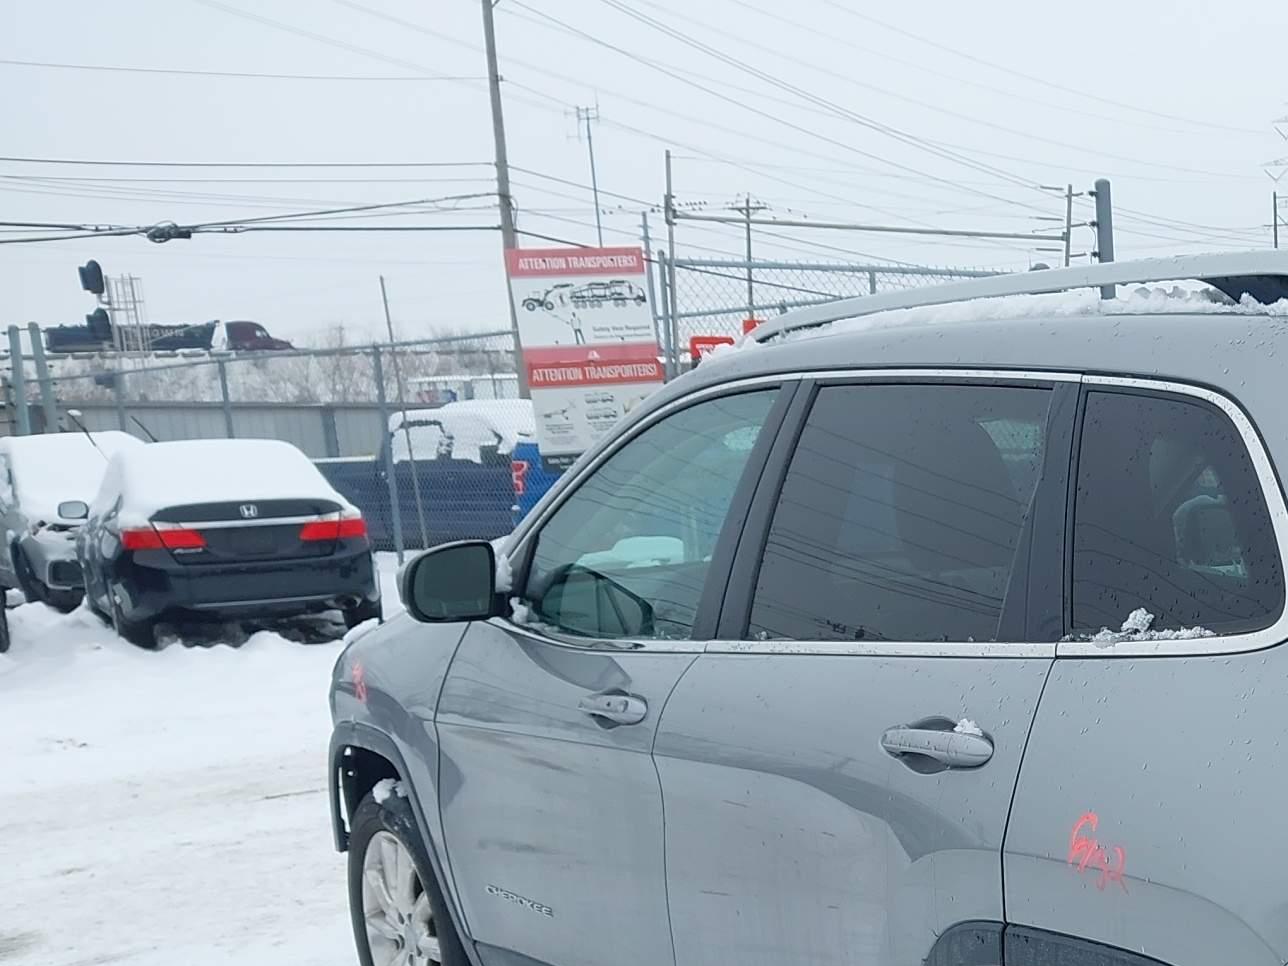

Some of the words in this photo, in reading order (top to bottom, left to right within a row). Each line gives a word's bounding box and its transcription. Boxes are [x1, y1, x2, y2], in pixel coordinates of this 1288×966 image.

[518, 257, 566, 270] ATTENTION
[567, 255, 638, 269] TRANSPORTERS!
[532, 367, 583, 383] ATTENTION
[584, 363, 657, 380] TRANSPORTERS!
